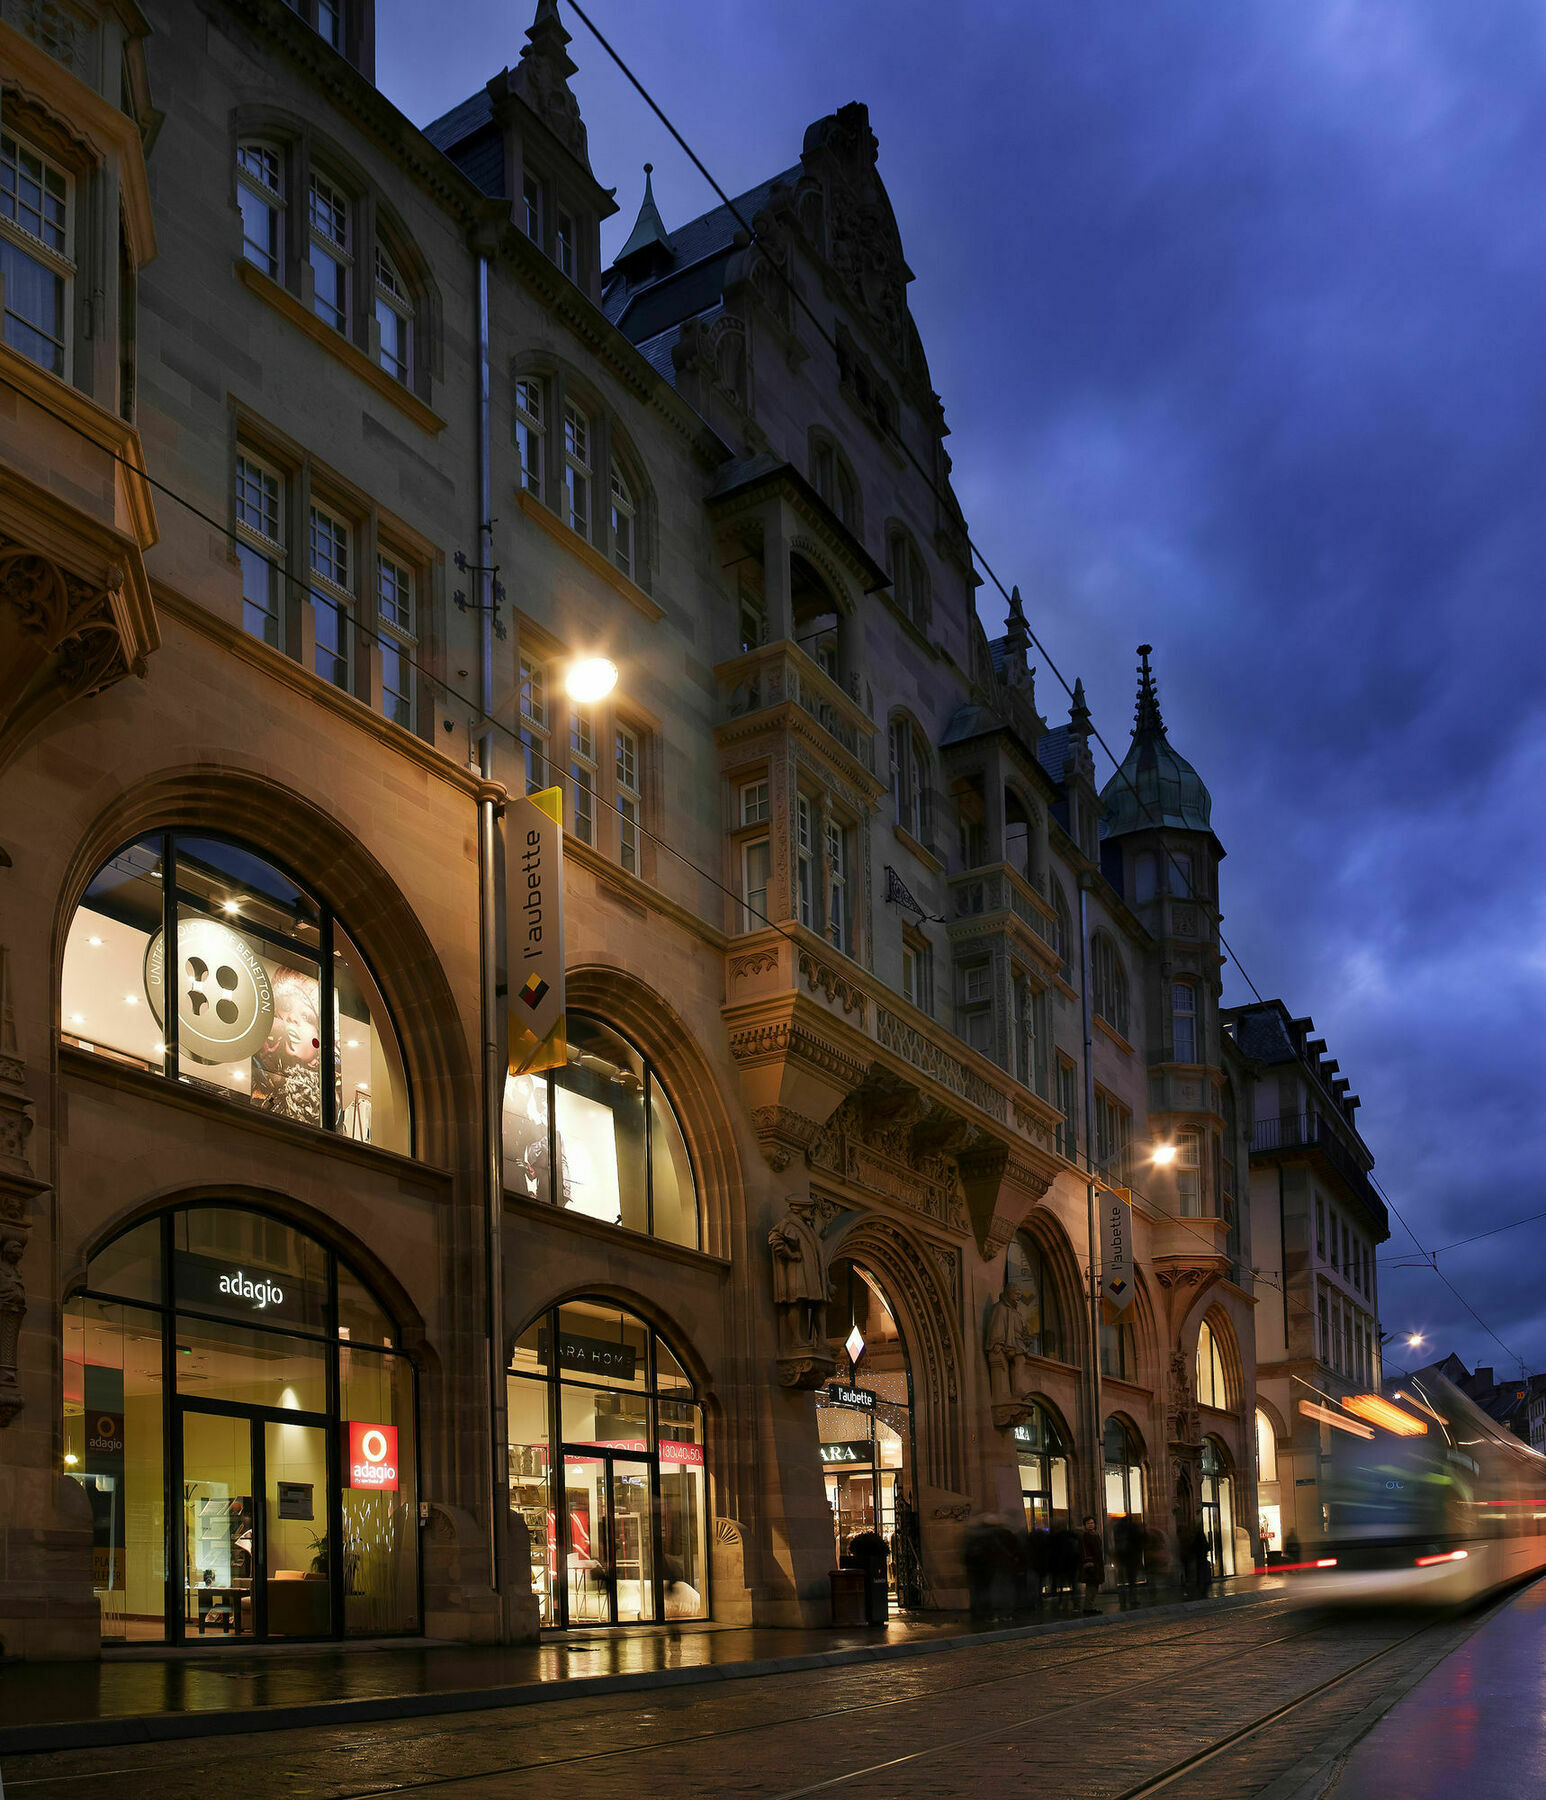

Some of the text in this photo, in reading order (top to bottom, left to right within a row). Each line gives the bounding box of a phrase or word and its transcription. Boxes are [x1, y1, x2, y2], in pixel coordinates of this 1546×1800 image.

[522, 829, 543, 959] l'aubette
[150, 938, 166, 985] UNITE
[1109, 1206, 1124, 1271] l'aubette
[219, 1270, 284, 1309] adagio
[592, 1350, 632, 1367] HOM
[837, 1386, 873, 1407] l'aubette
[89, 1434, 123, 1452] adagio
[1013, 1426, 1031, 1441] ARA
[819, 1445, 857, 1462] ARA
[353, 1459, 397, 1485] adagio
